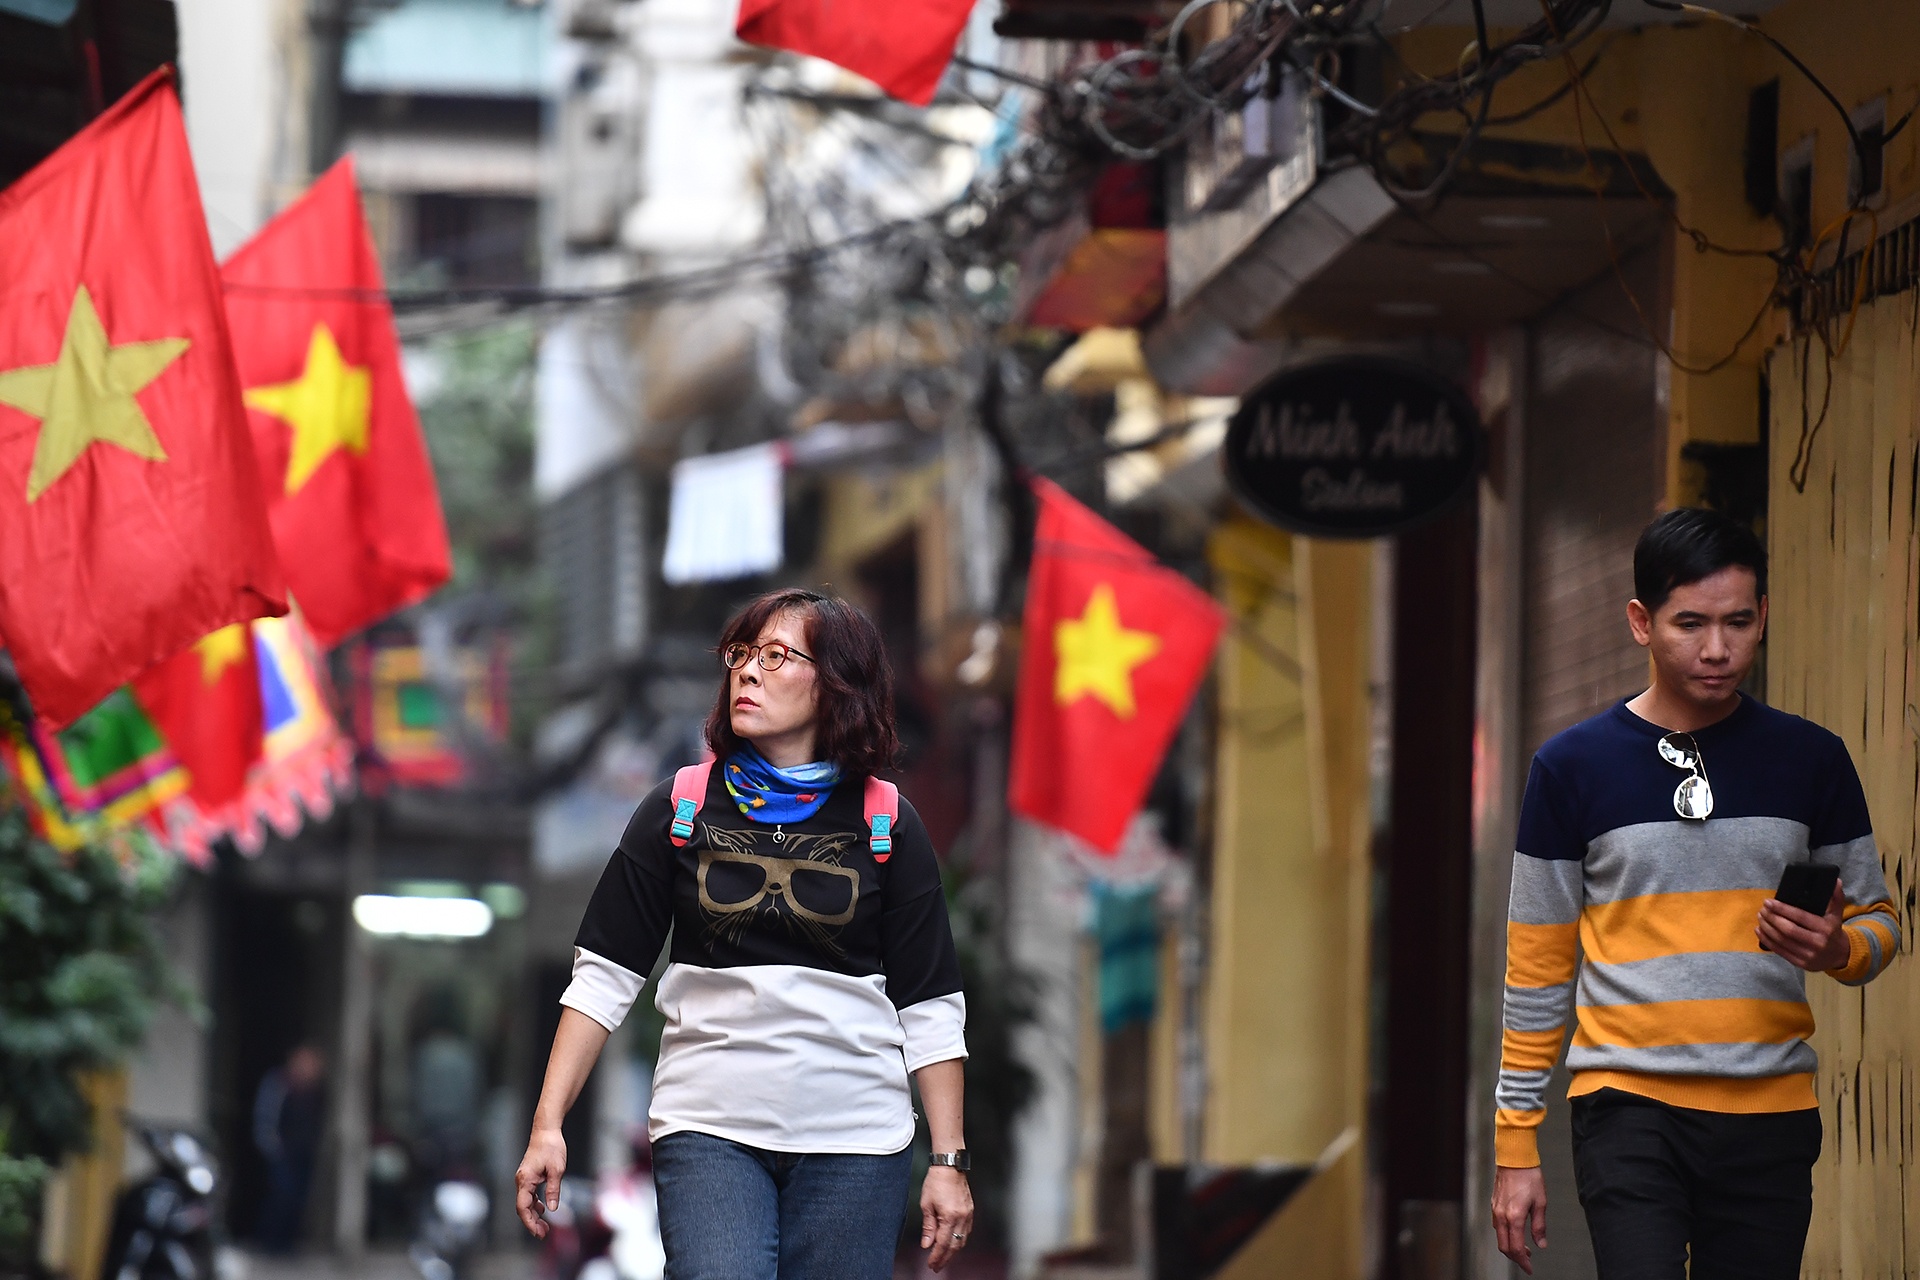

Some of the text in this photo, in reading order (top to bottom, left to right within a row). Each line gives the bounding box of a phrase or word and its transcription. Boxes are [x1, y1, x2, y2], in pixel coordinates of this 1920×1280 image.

[1246, 398, 1458, 459] Minh Anh
[1301, 466, 1404, 511] Salon
